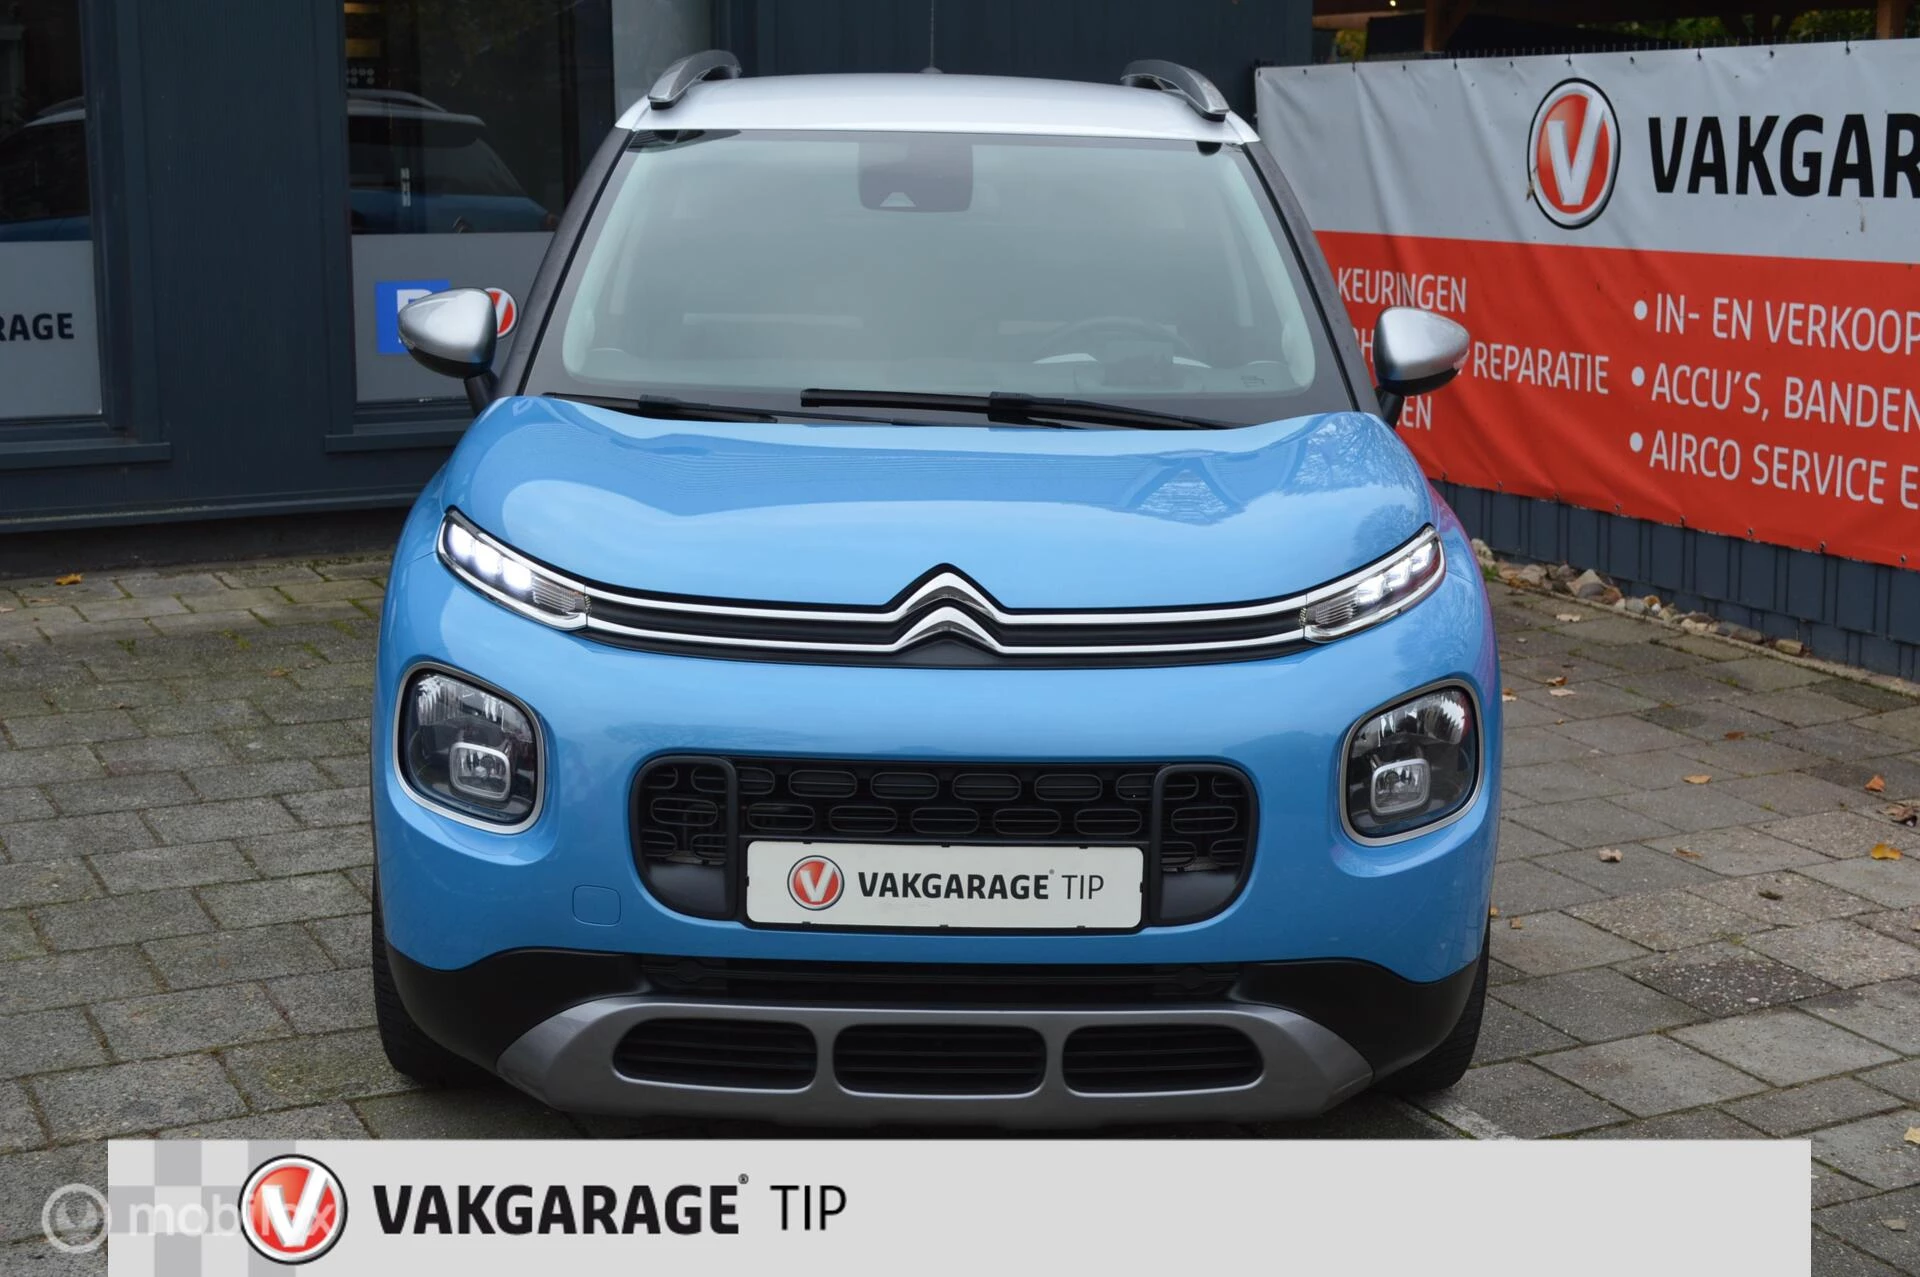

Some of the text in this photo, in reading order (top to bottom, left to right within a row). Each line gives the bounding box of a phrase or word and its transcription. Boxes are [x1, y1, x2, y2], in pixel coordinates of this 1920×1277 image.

[1648, 112, 1920, 198] VAKGAR
[1337, 267, 1467, 313] KEURINGEN
[1656, 292, 1920, 355] IN- EN VERKOOP
[1473, 341, 1609, 394] REPARATIE
[1397, 394, 1432, 431] EN
[1784, 376, 1920, 433] BANDEN
[1649, 430, 1741, 481] AIRCO
[1751, 444, 1887, 505] SERVICE
[858, 871, 1049, 900] VAKGARAGE
[1061, 874, 1104, 900] TIP
